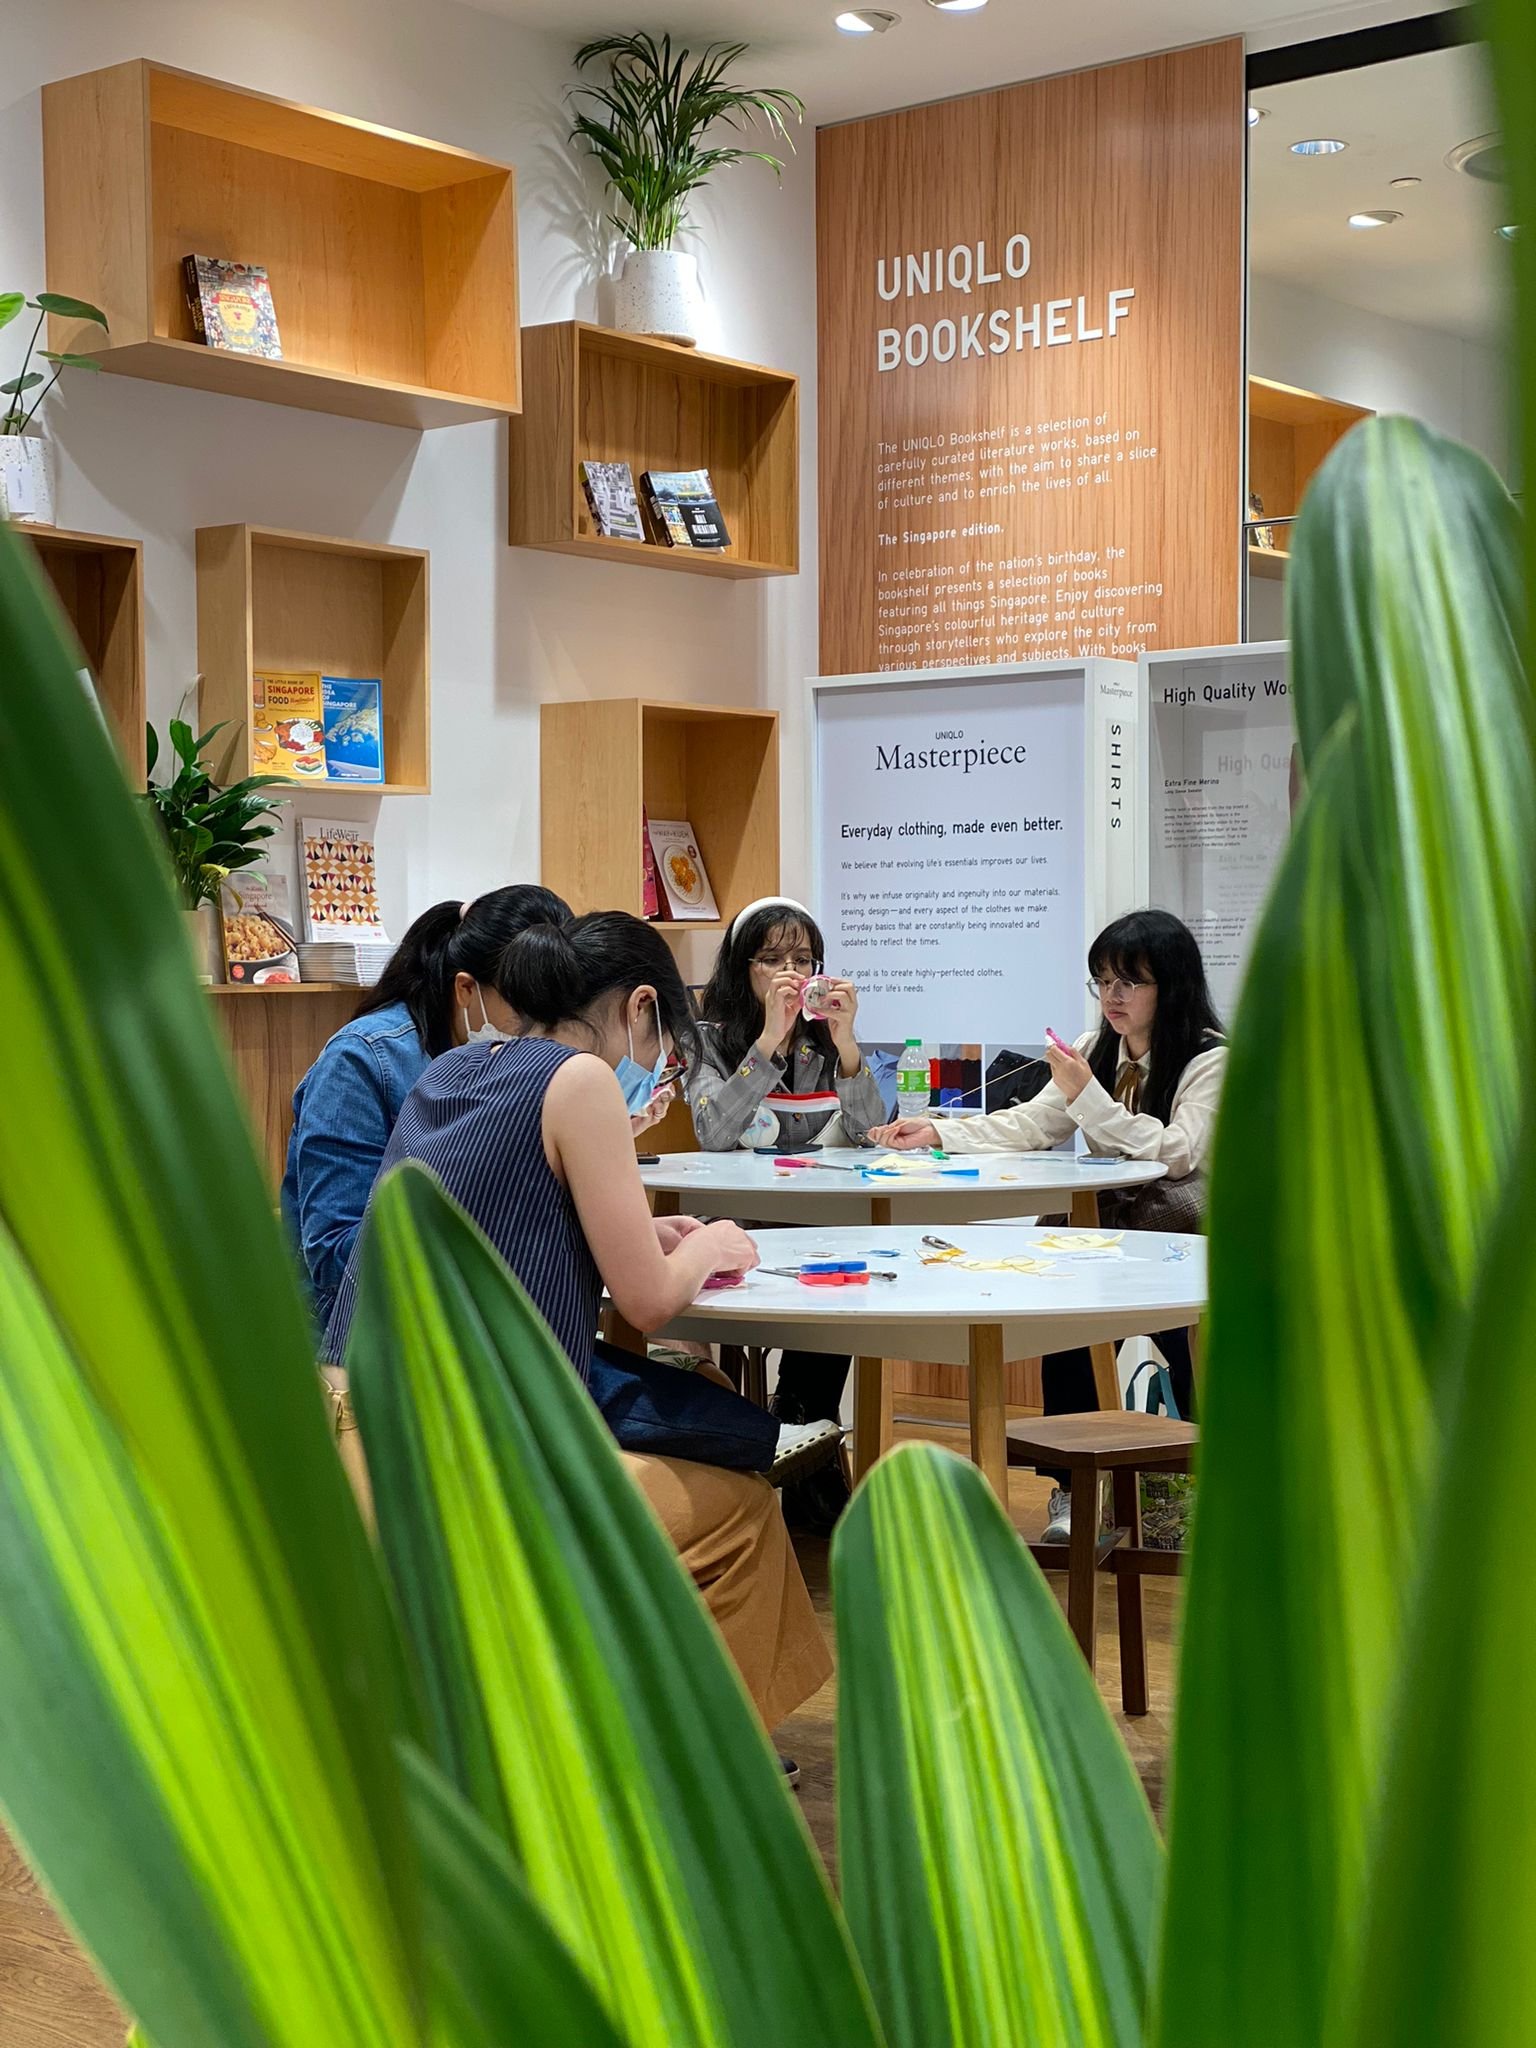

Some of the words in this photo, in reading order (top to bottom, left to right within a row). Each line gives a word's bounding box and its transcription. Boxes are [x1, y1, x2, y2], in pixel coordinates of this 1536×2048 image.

[878, 233, 1031, 301] UNIQLO
[878, 287, 1135, 372] BOOKSHELF
[878, 442, 898, 455] The
[903, 434, 945, 452] UNIQLO
[950, 425, 1005, 445] Bookshelf
[1010, 424, 1020, 437] is
[1024, 425, 1032, 435] a
[1037, 416, 1089, 434] selection
[1095, 412, 1107, 426] of
[878, 457, 926, 473] carefully
[931, 449, 974, 466] curated
[980, 443, 1035, 460] literature
[1085, 429, 1119, 446] based
[1125, 430, 1140, 441] on
[878, 475, 925, 491] different
[979, 465, 1004, 479] with
[1009, 462, 1027, 475] the
[1033, 458, 1054, 472] aim
[1060, 456, 1072, 468] to
[1077, 453, 1110, 466] share
[1116, 452, 1123, 461] a
[1129, 446, 1157, 460] slice
[878, 497, 888, 510] of
[893, 494, 933, 508] culture
[938, 489, 958, 503] and
[964, 488, 974, 500] to
[980, 482, 1016, 497] enrich
[1022, 480, 1040, 492] the
[1045, 477, 1071, 490] lives
[1077, 472, 1089, 486] of
[1094, 470, 1113, 484] all.
[878, 533, 898, 546] The
[903, 528, 957, 544] Singapore
[962, 522, 1004, 537] edition.
[878, 571, 887, 583] In
[893, 564, 954, 581] celebration
[959, 561, 970, 574] of
[976, 560, 993, 572] the
[999, 554, 1043, 570] nation's
[1106, 546, 1125, 560] the
[878, 584, 929, 600] bookshelf
[935, 580, 982, 597] presents
[987, 580, 994, 590] a
[999, 574, 1050, 589] selection
[1056, 570, 1068, 584] of
[1073, 568, 1108, 582] books
[878, 604, 928, 618] featuring
[933, 601, 946, 614] all
[951, 598, 985, 613] things
[1056, 589, 1089, 603] Enjoy
[1094, 581, 1163, 599] discovering
[878, 620, 940, 638] Singapore's
[944, 615, 996, 631] colourful
[1000, 611, 1049, 627] heritage
[1054, 607, 1076, 622] and
[1081, 605, 1125, 619] culture
[878, 640, 921, 655] through
[926, 635, 990, 652] storytellers
[995, 632, 1019, 645] who
[1024, 629, 1068, 645] explore
[1073, 625, 1093, 639] the
[1098, 623, 1121, 639] city
[1126, 621, 1157, 635] from
[878, 659, 917, 672] various
[922, 653, 991, 670] perspectives
[996, 650, 1017, 663] and
[1078, 643, 1106, 657] With
[1111, 641, 1147, 653] books
[267, 685, 315, 695] SINGAPORE
[268, 696, 290, 704] FOOD
[1100, 684, 1133, 699] Masterpiece
[1164, 687, 1196, 706] High
[1203, 682, 1256, 703] Quality
[935, 730, 964, 741] UNIQLO
[875, 739, 1027, 774] Masterpiece
[1111, 724, 1122, 829] SHIRTS
[320, 827, 359, 841] LifeWear
[841, 823, 893, 841] Everyday
[898, 821, 947, 839] clothing,
[952, 819, 985, 835] made
[990, 819, 1018, 833] even
[1023, 816, 1063, 832] better.
[841, 861, 852, 870] We
[854, 860, 878, 870] believe
[880, 859, 894, 869] that
[896, 859, 924, 870] evolving
[944, 857, 978, 867] essentials
[980, 857, 1013, 868] improves
[1015, 856, 1028, 865] our
[853, 892, 867, 902] why
[870, 892, 880, 900] we
[882, 890, 903, 900] infuse
[905, 889, 940, 901] originality
[942, 889, 955, 899] and
[957, 889, 990, 900] ingenuity
[992, 888, 1007, 897] into
[1008, 888, 1021, 897] our
[913, 907, 933, 915] every
[935, 905, 959, 915] aspect
[961, 904, 969, 914] of
[971, 904, 983, 914] the
[985, 903, 1011, 913] clothes
[1014, 904, 1025, 913] we
[841, 922, 873, 933] Everyday
[875, 921, 896, 931] basics
[898, 921, 912, 931] that
[914, 921, 927, 930] are
[929, 920, 965, 932] constantly
[967, 920, 987, 931] being
[989, 920, 1024, 929] innovated
[1026, 919, 1040, 929] and
[841, 937, 868, 948] updated
[870, 938, 878, 947] to
[880, 937, 903, 946] reflect
[905, 936, 917, 946] the
[841, 968, 854, 978] Our
[856, 968, 871, 979] goal
[873, 968, 879, 978] is
[881, 968, 889, 978] to
[890, 968, 913, 978] create
[873, 983, 882, 993] for
